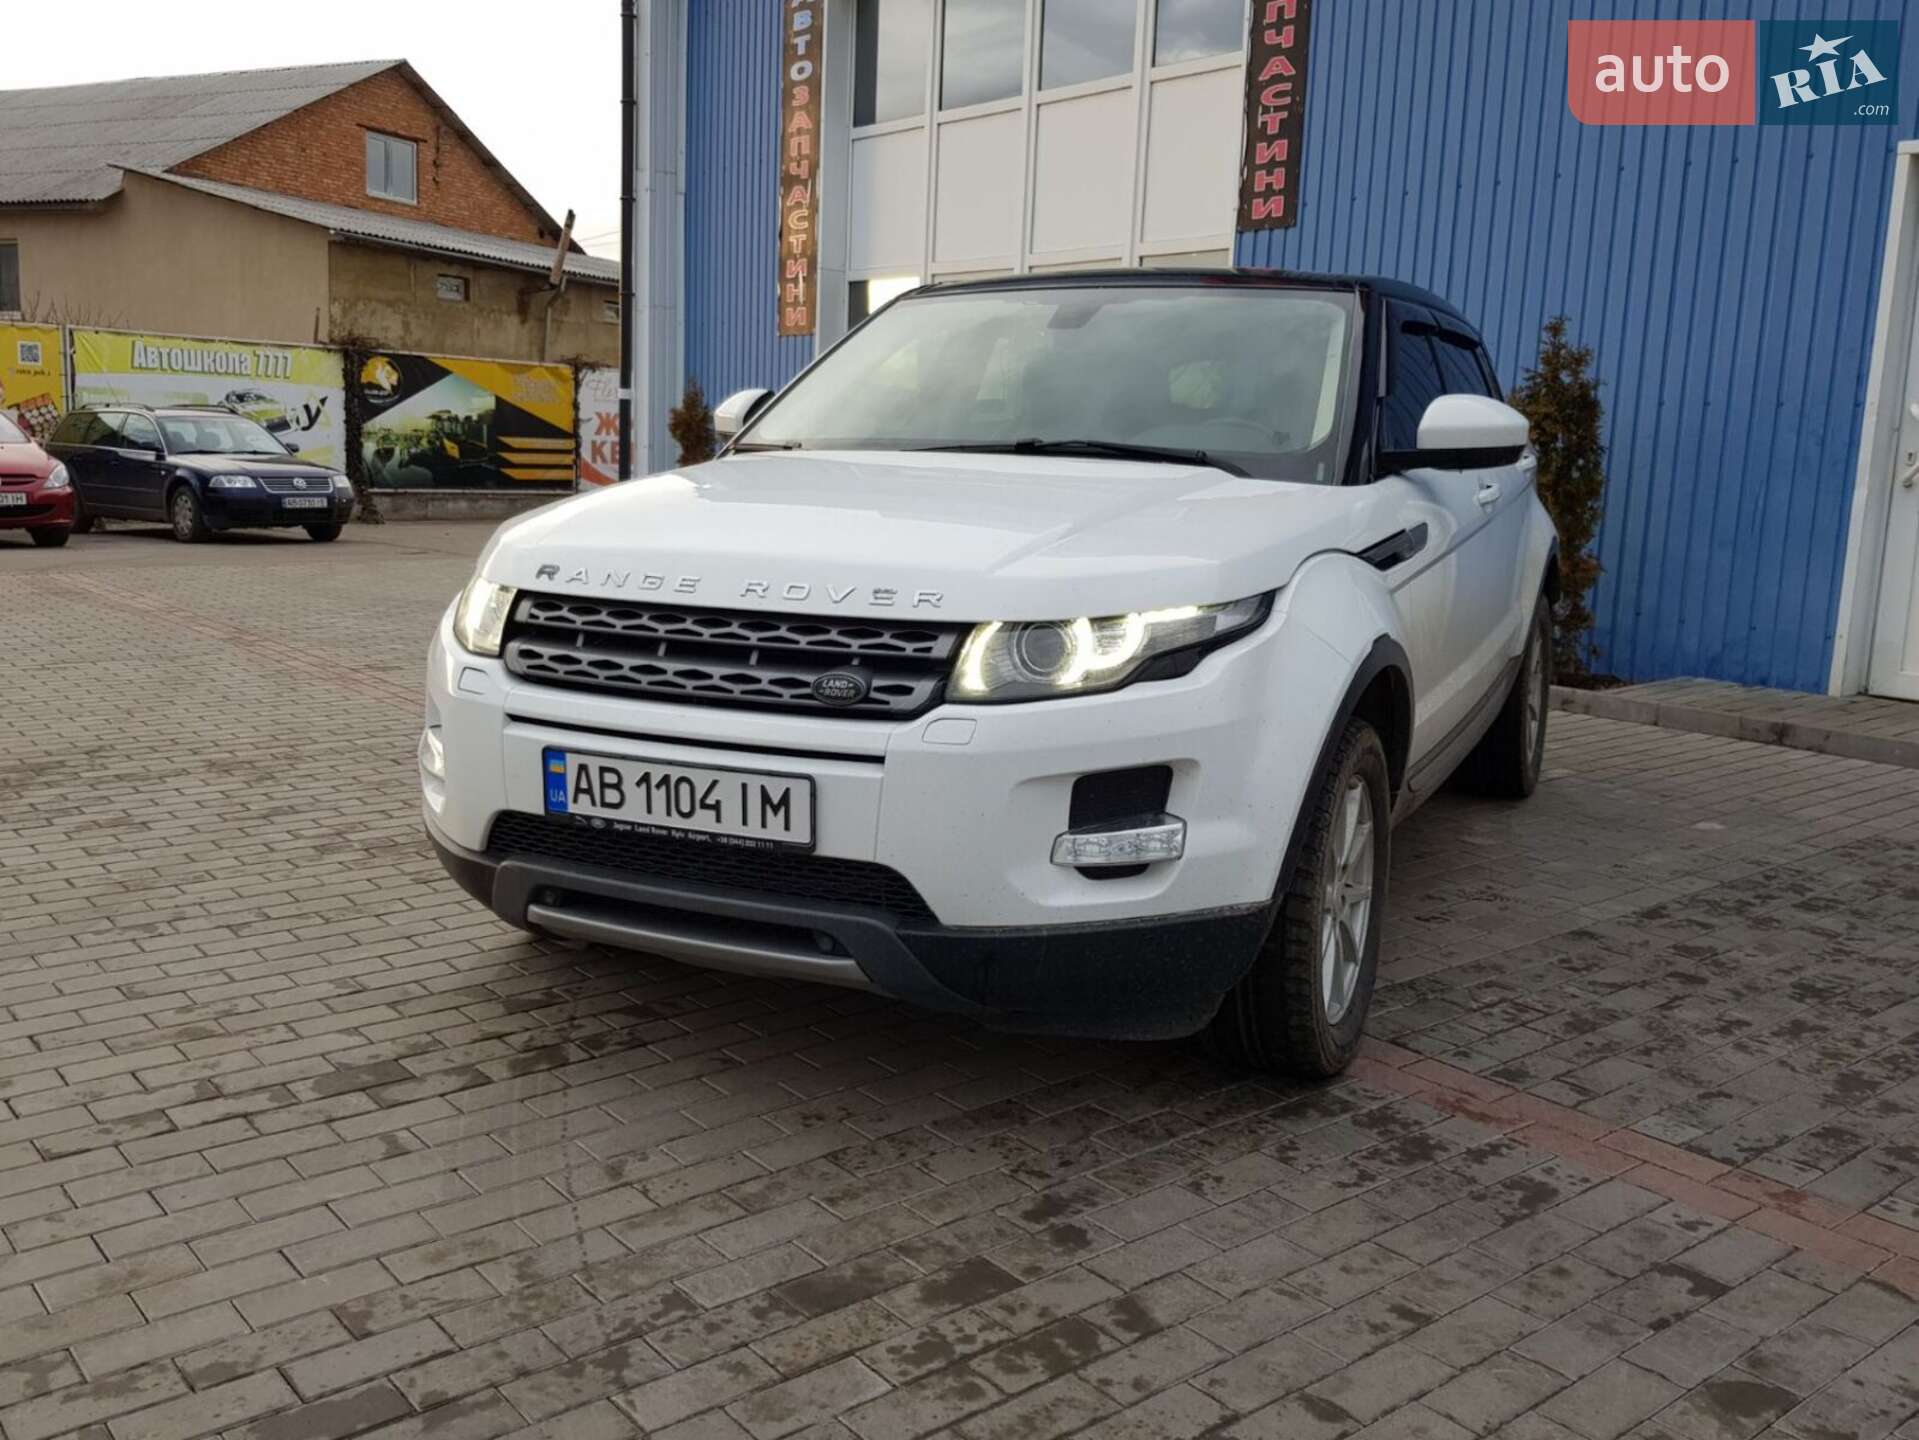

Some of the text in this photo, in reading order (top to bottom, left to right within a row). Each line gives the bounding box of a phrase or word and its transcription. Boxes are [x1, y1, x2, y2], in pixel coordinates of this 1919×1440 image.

[1251, 0, 1298, 220] ПЧАСТИНИ
[784, 0, 814, 326] ВТОЗАПЧАСТИНИ
[132, 337, 293, 380] Автошкола 7777
[535, 563, 945, 609] RANGE ROVER
[822, 679, 848, 689] LAND
[823, 688, 856, 698] ROVER
[549, 788, 566, 803] UA
[572, 763, 790, 832] AB 1104 IM
